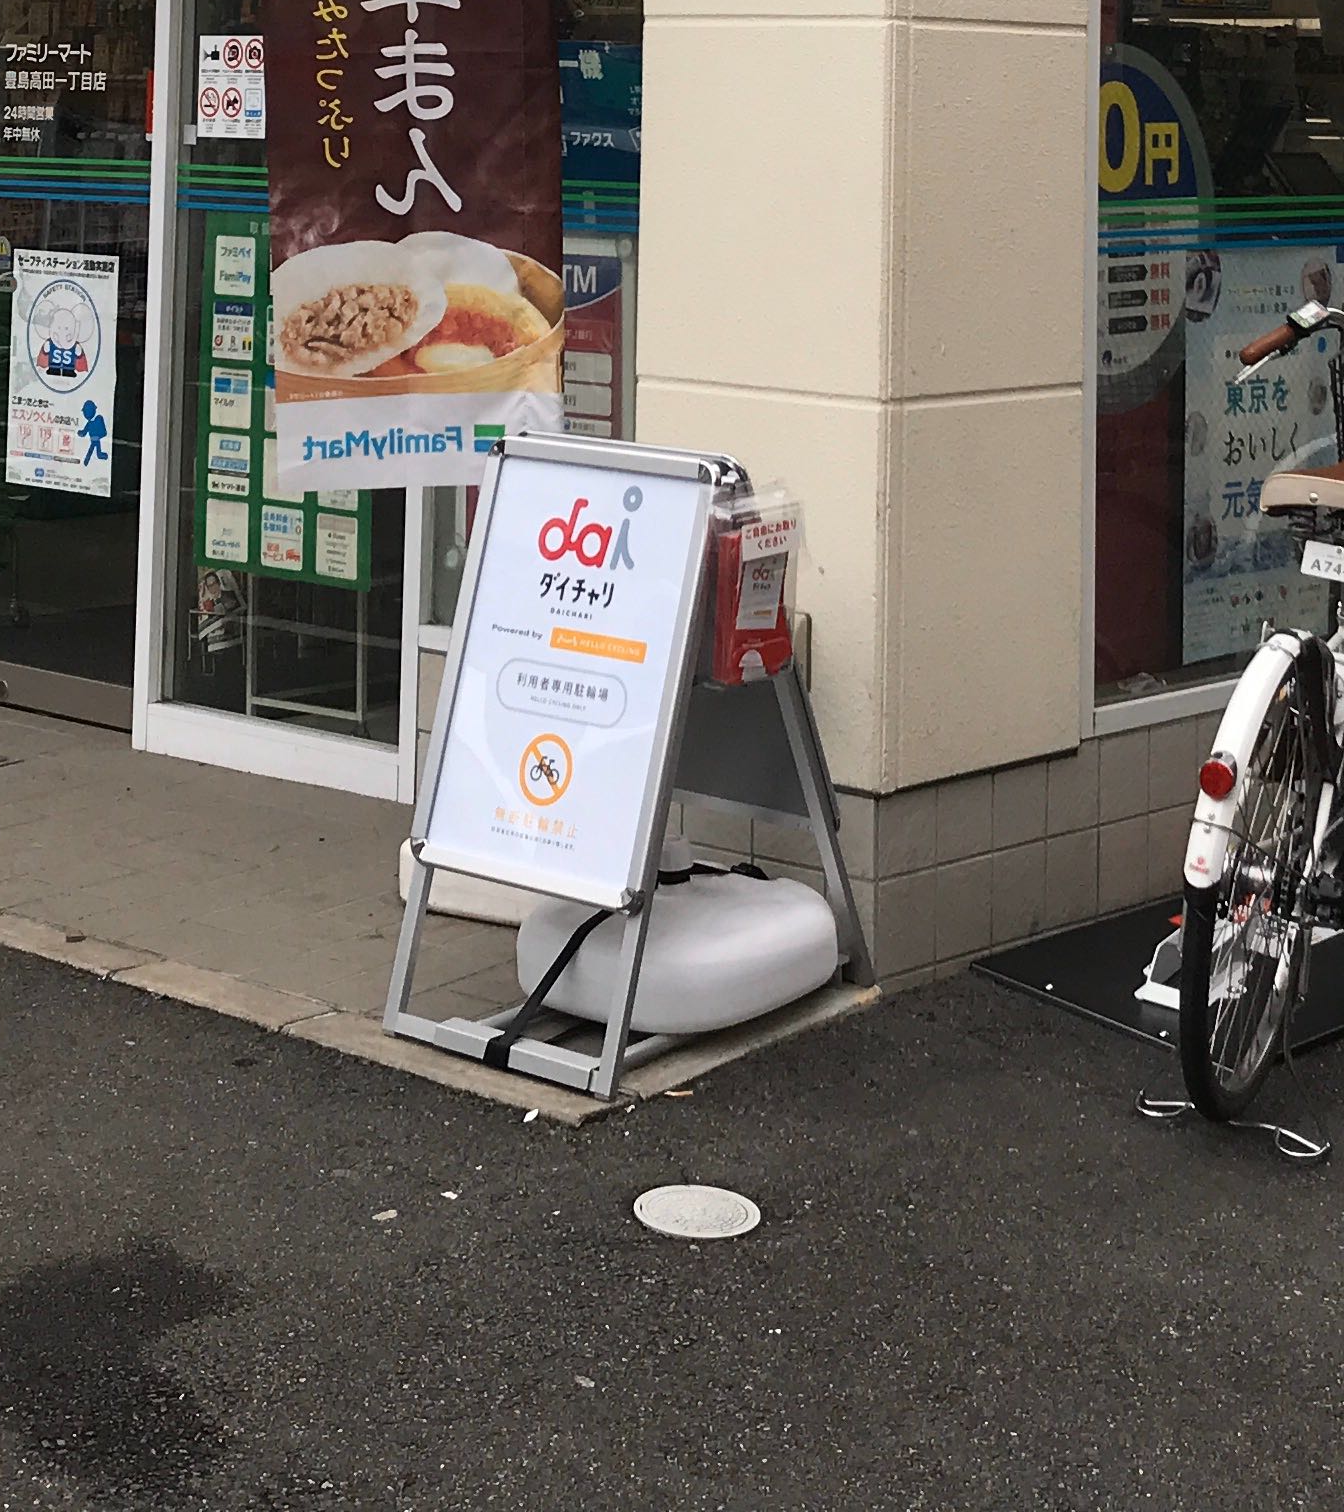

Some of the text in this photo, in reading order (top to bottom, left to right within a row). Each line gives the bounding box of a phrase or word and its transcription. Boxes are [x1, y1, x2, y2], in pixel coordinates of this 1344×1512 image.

[6, 43, 92, 64] ファミリーマート
[5, 70, 107, 91] 豊島高田一丁目店
[3, 105, 54, 121] 24時間営業
[562, 264, 597, 294] TM
[52, 349, 72, 365] SS
[1224, 375, 1290, 417] 東京を
[1223, 422, 1299, 467] おいしく
[540, 572, 616, 609] ダイチャリ
[491, 623, 530, 638] Powered
[531, 628, 543, 641] by
[516, 671, 610, 702] 利用者専用駐輪場
